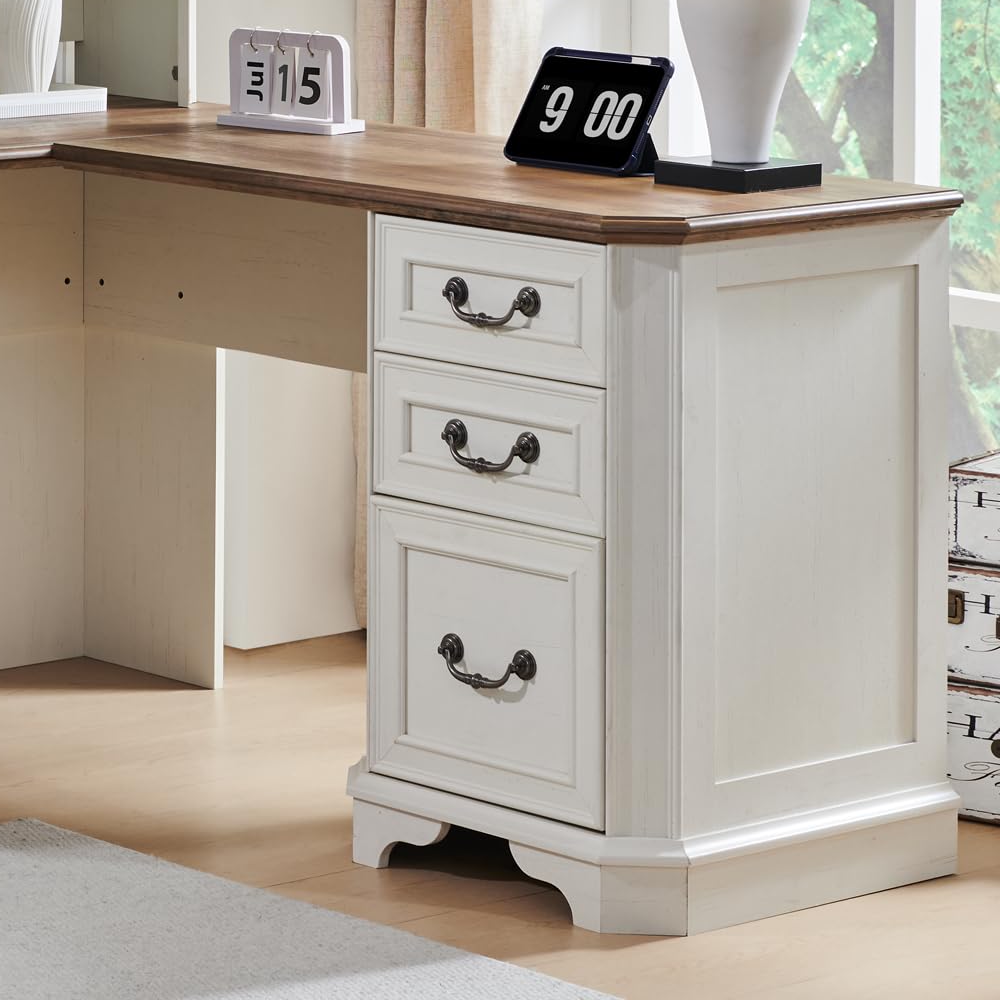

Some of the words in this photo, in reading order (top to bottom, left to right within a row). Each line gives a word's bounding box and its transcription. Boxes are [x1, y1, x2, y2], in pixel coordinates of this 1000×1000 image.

[246, 61, 264, 102] Jul
[278, 64, 321, 105] 15
[539, 86, 574, 133] 9
[583, 90, 643, 141] 00
